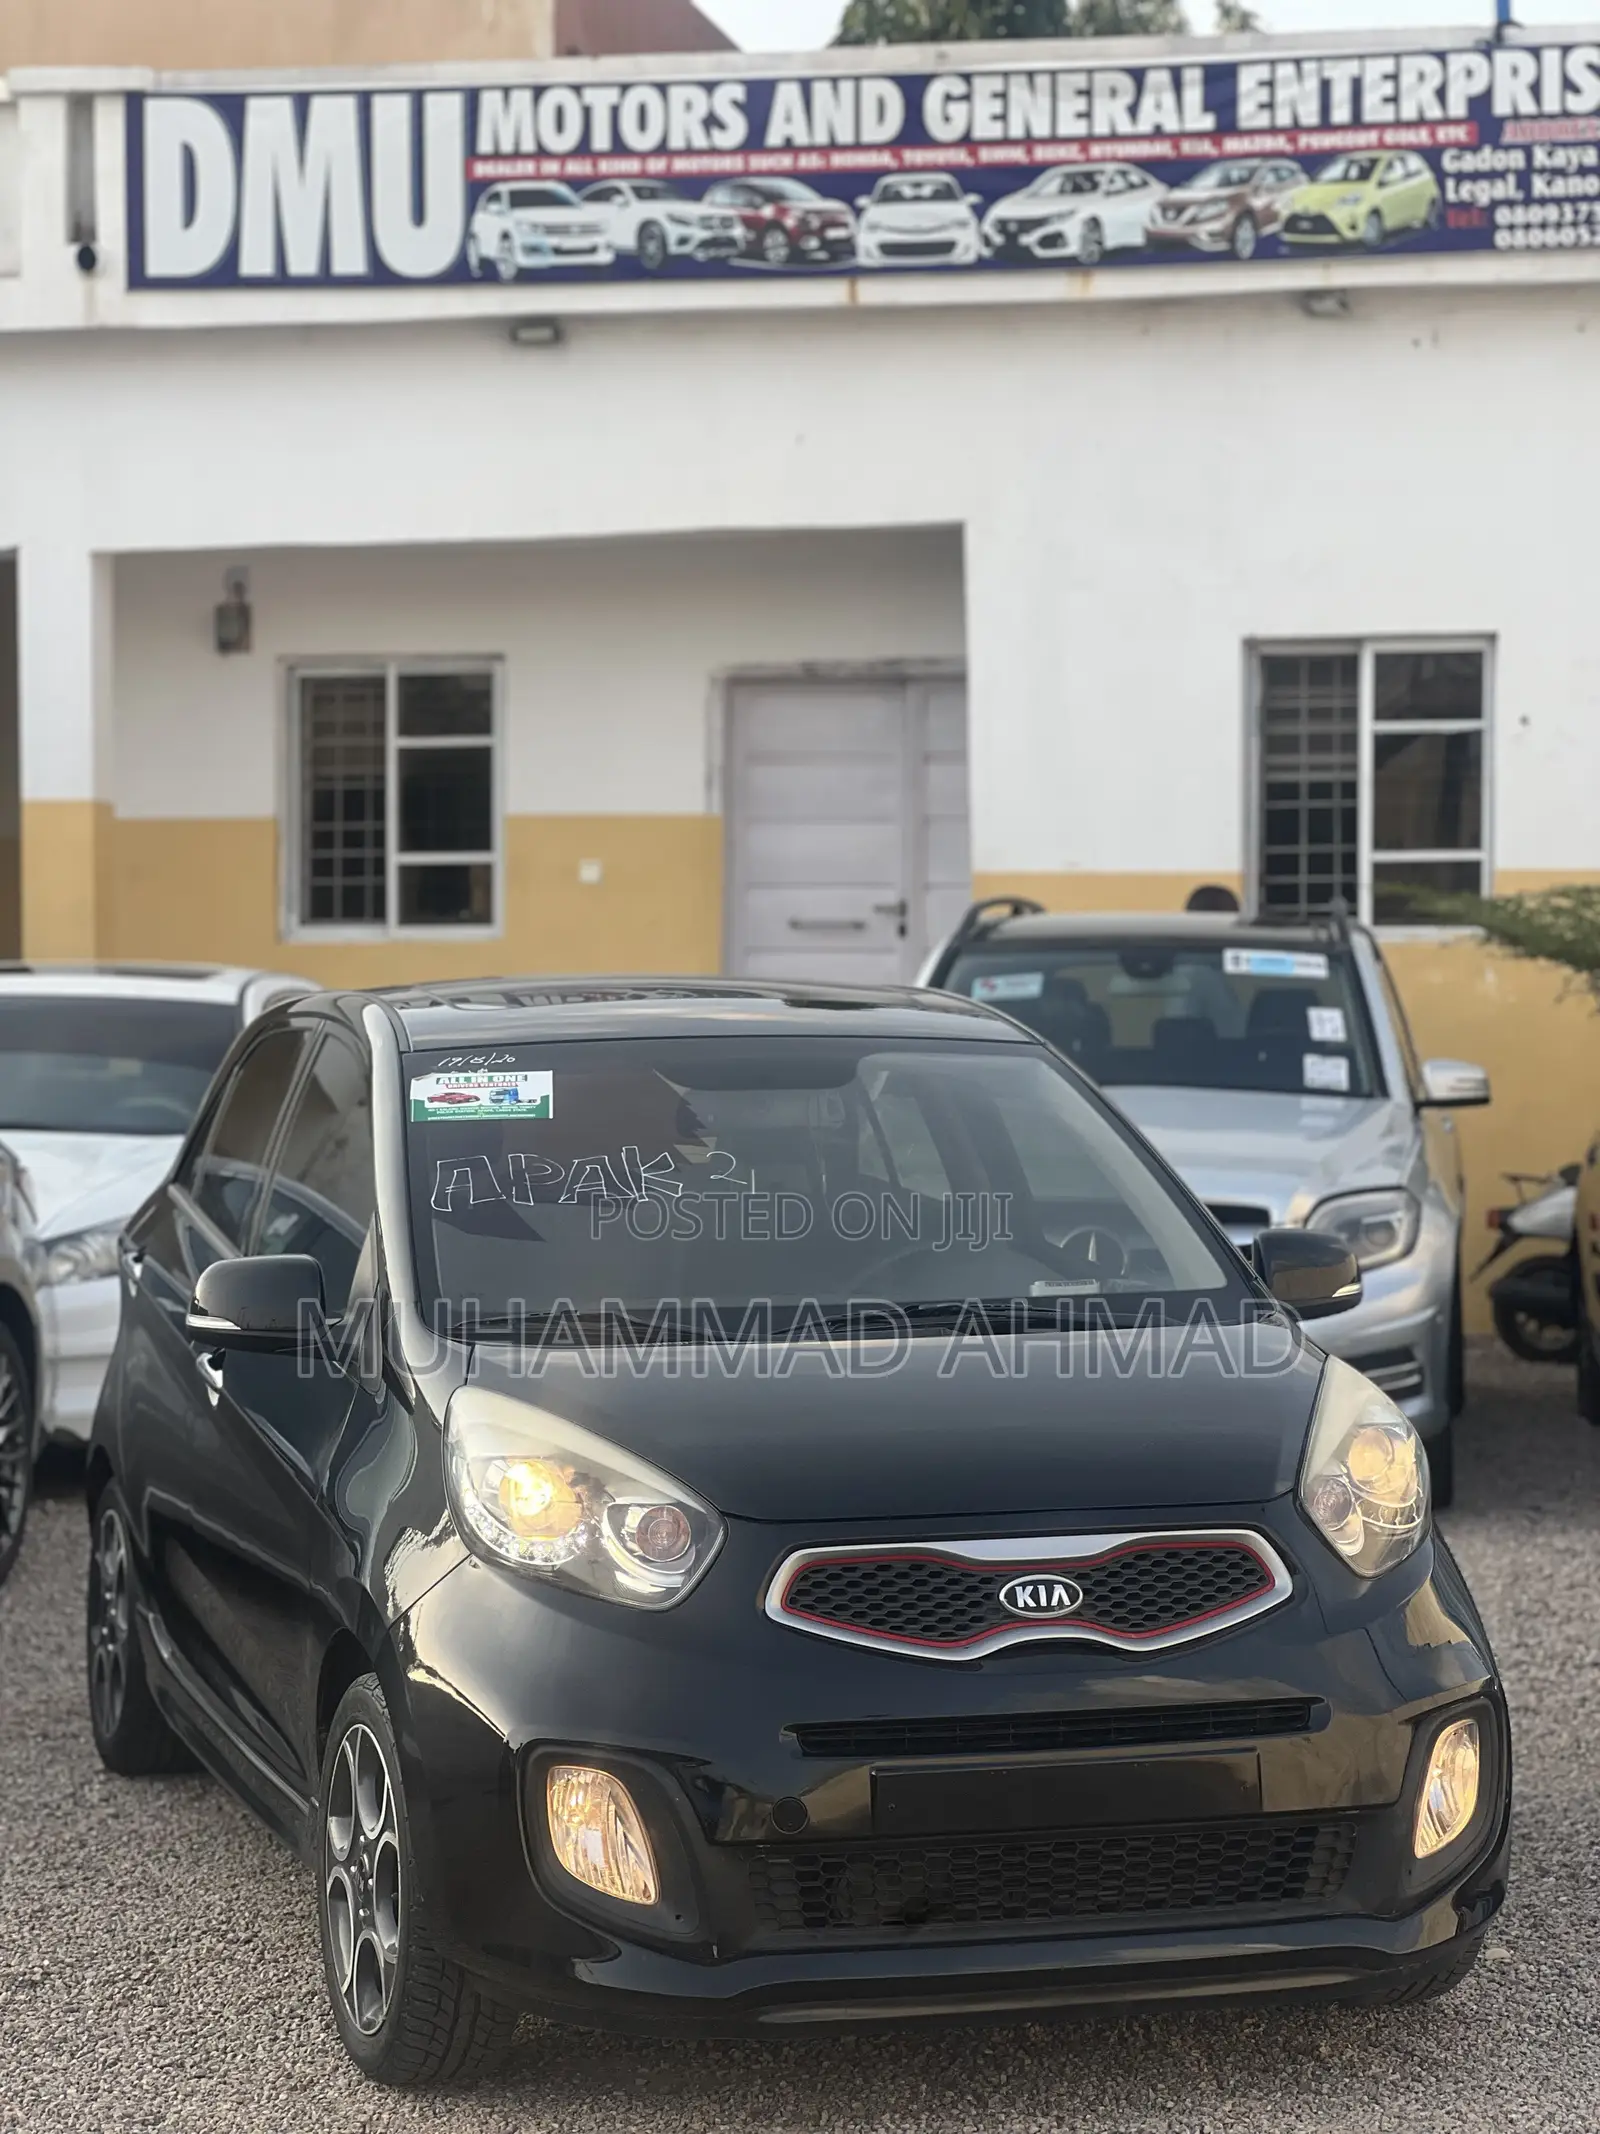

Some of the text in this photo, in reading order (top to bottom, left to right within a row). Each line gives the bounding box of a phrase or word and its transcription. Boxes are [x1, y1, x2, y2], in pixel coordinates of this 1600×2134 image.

[476, 45, 1600, 155] MOTORS AND GENERAL ENTERPRIS
[1441, 143, 1599, 174] Gadon Kaya
[143, 93, 465, 278] DMU
[1531, 172, 1600, 199] Kano
[438, 1077, 468, 1085] ALL
[471, 1075, 489, 1083] IN
[1014, 1584, 1071, 1608] KIA
